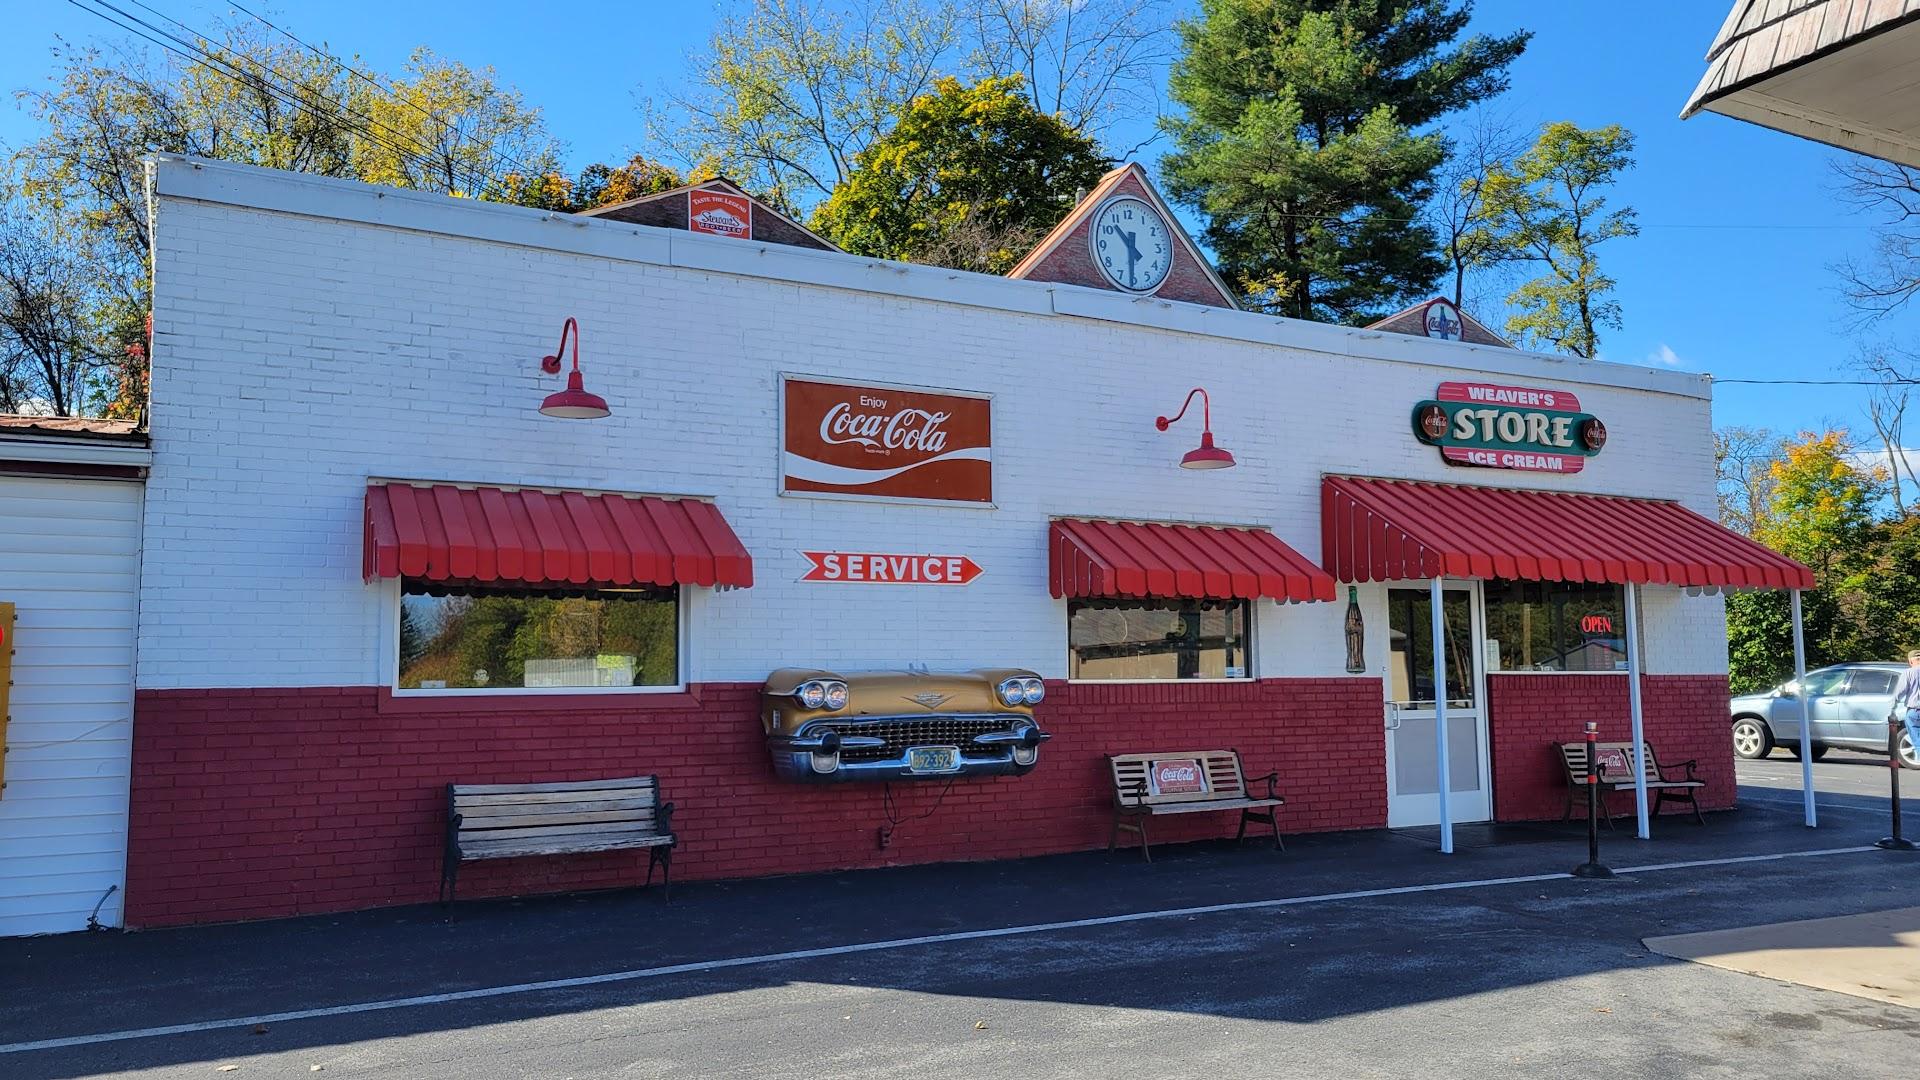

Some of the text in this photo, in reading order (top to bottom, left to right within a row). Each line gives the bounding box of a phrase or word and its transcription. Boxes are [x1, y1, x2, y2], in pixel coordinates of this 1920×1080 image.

[724, 198, 747, 213] LEGEND
[1112, 213, 1120, 223] 11
[1123, 209, 1133, 220] 12
[1141, 215, 1145, 225] 1
[1102, 225, 1114, 235] 10
[1150, 226, 1156, 237] 2
[1099, 239, 1107, 252] 9
[1155, 243, 1162, 254] 3
[1104, 256, 1112, 268] 8
[1151, 260, 1159, 271] 4
[1117, 269, 1124, 280] 7
[1144, 271, 1151, 282] 5
[860, 395, 887, 410] Enjoy
[1467, 386, 1555, 407] WEAVER'S
[820, 402, 952, 452] Coca-Cola
[1453, 408, 1574, 448] STORE
[1468, 452, 1563, 471] ICE CREAM
[823, 554, 962, 582] SERVICE
[1582, 616, 1612, 633] OPEN
